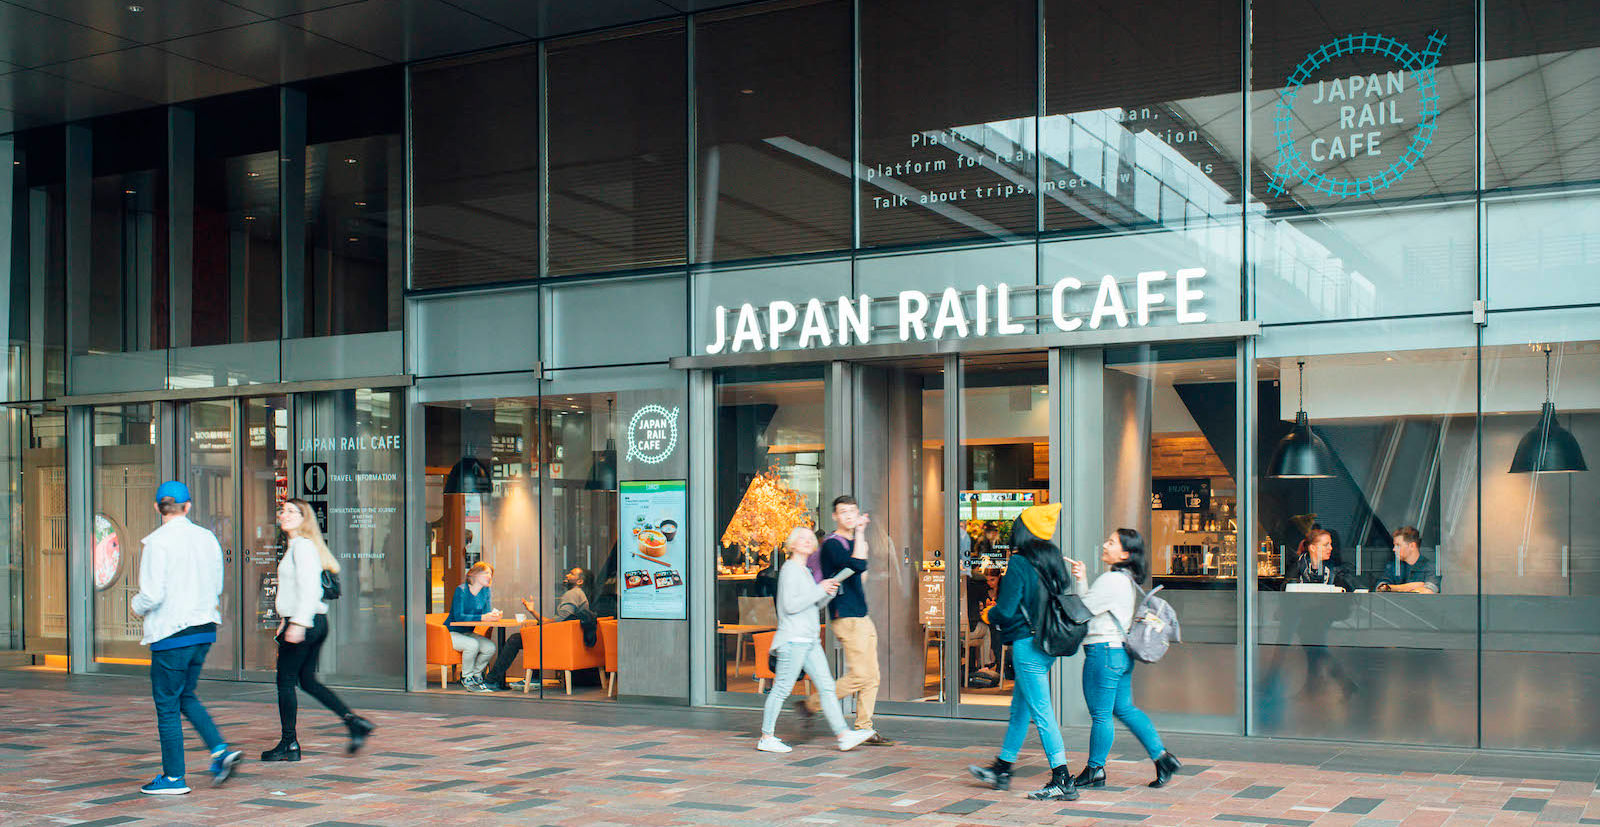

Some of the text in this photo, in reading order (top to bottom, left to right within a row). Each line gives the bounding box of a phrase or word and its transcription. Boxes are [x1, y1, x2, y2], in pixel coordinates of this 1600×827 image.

[1312, 69, 1404, 105] JAPAN
[1340, 100, 1404, 130] RAIL
[1310, 131, 1382, 162] CAFE
[867, 158, 947, 182] platform
[956, 153, 985, 169] for
[873, 194, 908, 209] Talk
[920, 189, 967, 204] about
[975, 184, 1032, 198] trips,
[1043, 177, 1087, 191] meet
[706, 268, 1207, 354] JAPAN RAIL CAFE
[639, 419, 667, 430] JAPAN
[646, 429, 667, 440] RAIL
[300, 435, 401, 452] JAPAN RAIL CAFE
[638, 440, 660, 451] CAFE
[330, 473, 397, 482] TRAVEL INFORMATION
